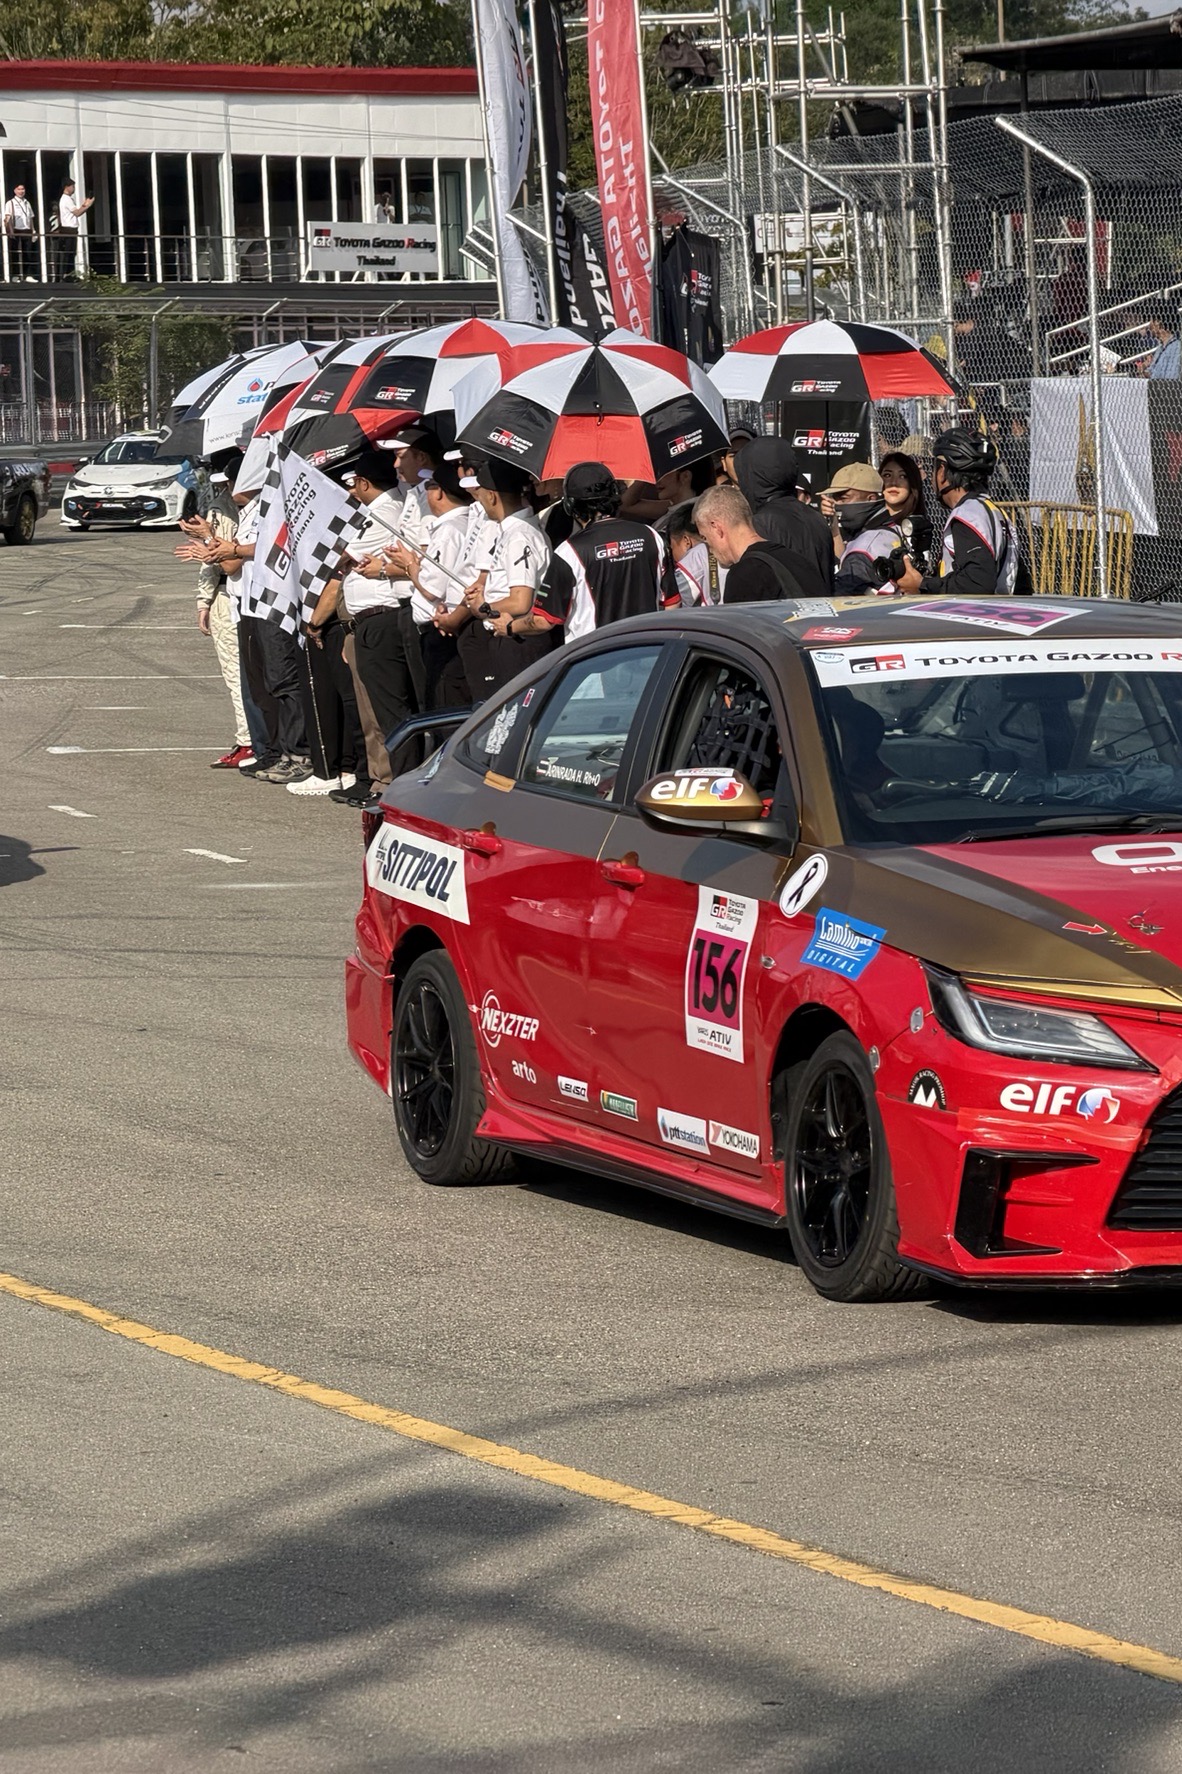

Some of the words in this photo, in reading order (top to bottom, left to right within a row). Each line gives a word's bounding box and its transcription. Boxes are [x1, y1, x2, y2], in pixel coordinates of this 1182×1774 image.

[333, 237, 371, 248] TOYOTA
[372, 237, 404, 249] GAZOO
[404, 238, 437, 253] Racing
[356, 255, 396, 266] Thailand
[790, 384, 815, 392] GR
[489, 431, 511, 447] GR
[670, 441, 687, 456] GR
[793, 436, 822, 446] GR
[284, 471, 307, 513] OYOTA
[595, 547, 618, 560] GR
[928, 602, 1045, 623] 156
[852, 660, 904, 674] GR
[915, 653, 1038, 667] TOYOTA
[1046, 651, 1154, 662] GAZOO
[650, 777, 710, 800] elf
[382, 839, 458, 903] SITTIPOL
[710, 903, 727, 919] GR
[728, 898, 746, 910] TOYOTA
[727, 905, 744, 917] GAZOO
[806, 949, 856, 974] DIGITAL
[693, 938, 742, 1019] 156
[481, 1006, 540, 1041] NEXZTER
[710, 1030, 732, 1045] ATIV
[512, 1059, 537, 1084] arto
[1000, 1083, 1076, 1115] elf
[721, 1128, 758, 1154] YOKOHAMA
